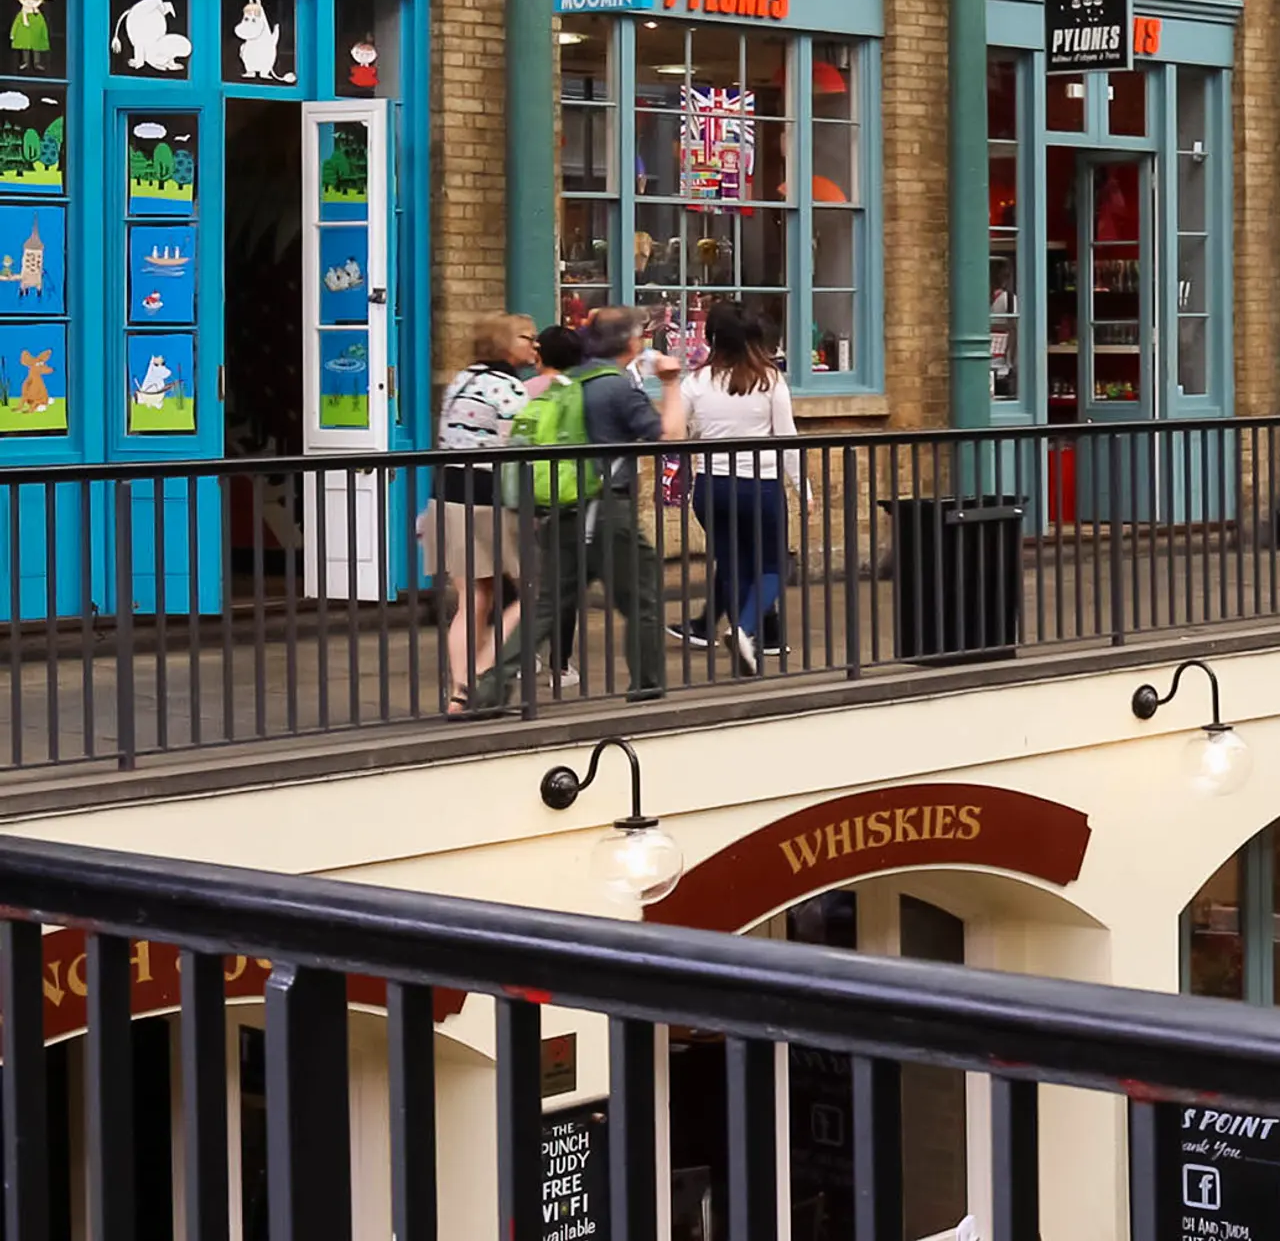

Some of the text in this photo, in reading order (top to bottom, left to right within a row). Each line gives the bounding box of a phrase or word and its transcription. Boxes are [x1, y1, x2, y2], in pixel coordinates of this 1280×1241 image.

[1052, 25, 1121, 54] PYLONES
[779, 805, 982, 875] WHISKIES
[552, 1122, 575, 1137] THE
[1199, 1110, 1280, 1140] POINT
[546, 1150, 591, 1177] JUDY
[1211, 1140, 1243, 1161] You
[542, 1173, 583, 1201] FREE
